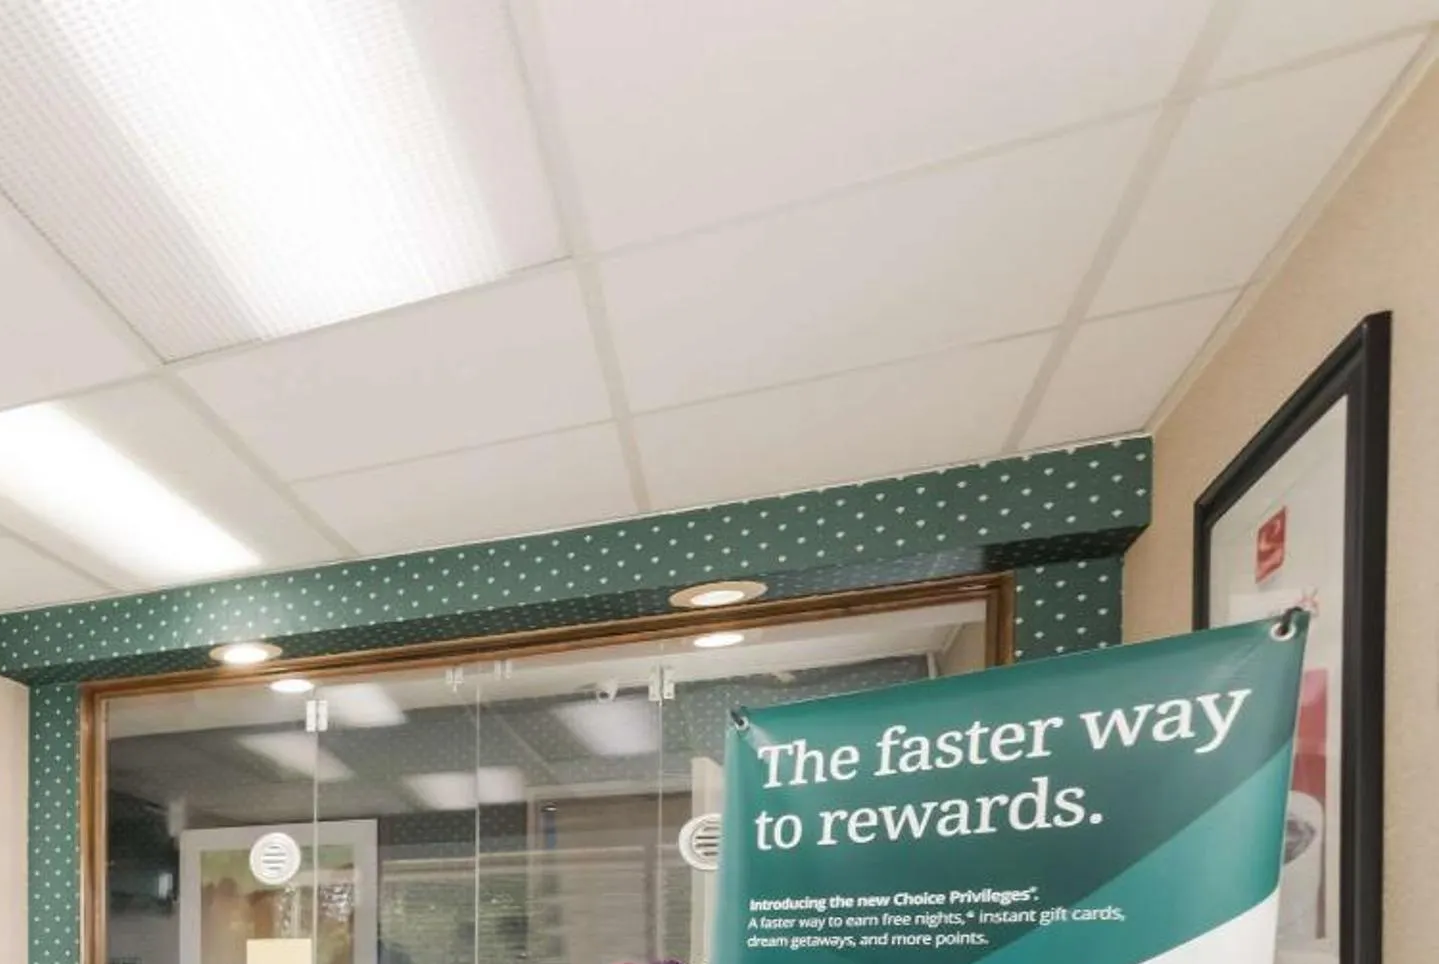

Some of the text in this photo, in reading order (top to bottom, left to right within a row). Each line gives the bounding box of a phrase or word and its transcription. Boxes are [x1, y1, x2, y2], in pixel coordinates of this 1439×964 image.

[758, 688, 1252, 789] The faster way
[755, 777, 1104, 850] to rewards.
[748, 895, 827, 912] Introducing
[829, 894, 854, 908] the
[857, 895, 890, 907] new
[894, 892, 946, 906] Choice
[747, 917, 758, 930] A
[761, 916, 796, 929] faster
[798, 917, 826, 931] way
[828, 916, 843, 927] to
[845, 915, 879, 926] earn
[881, 913, 912, 926] free
[979, 909, 1037, 924] instant
[1039, 905, 1068, 926] gift
[1071, 905, 1126, 921] cards,
[747, 932, 989, 950] dream getaways, and more points.
